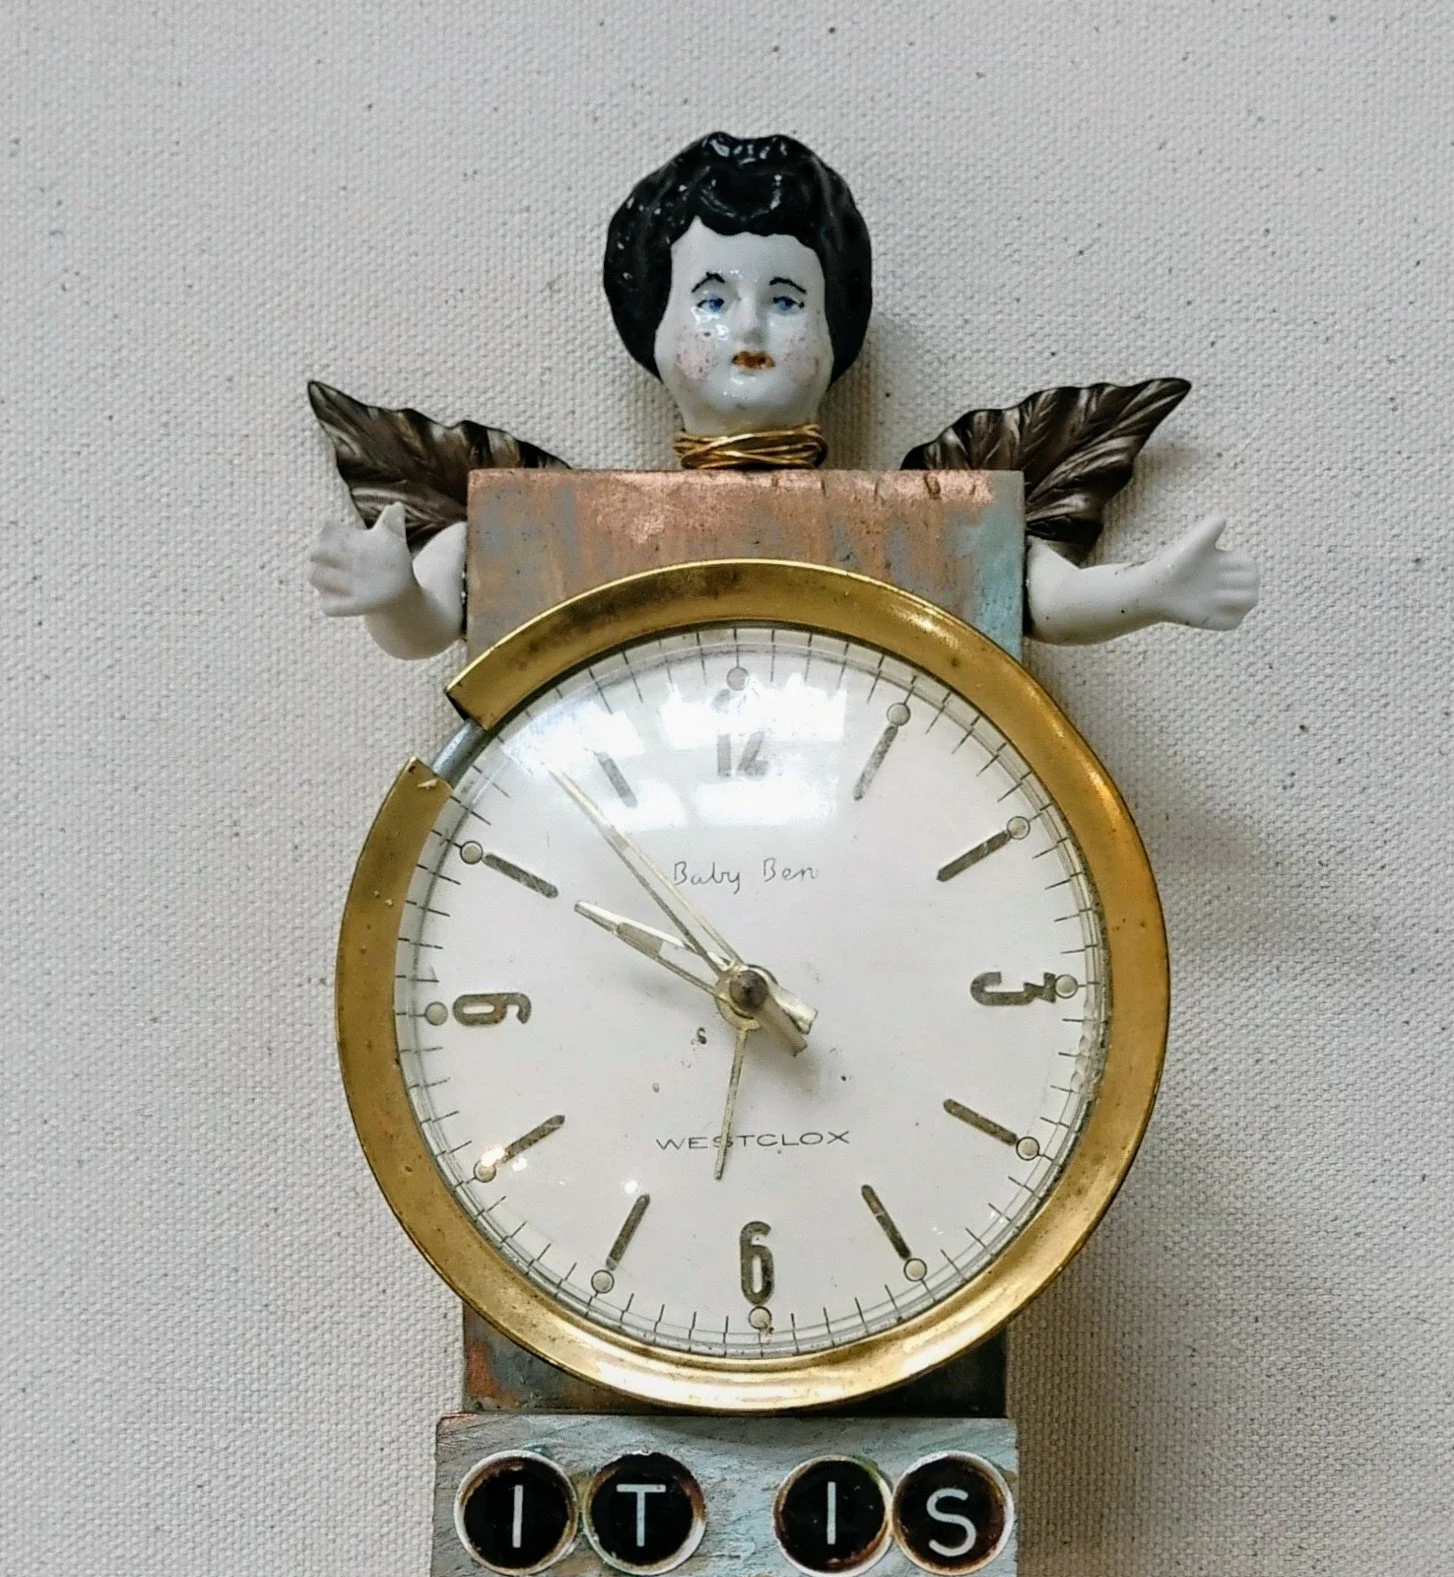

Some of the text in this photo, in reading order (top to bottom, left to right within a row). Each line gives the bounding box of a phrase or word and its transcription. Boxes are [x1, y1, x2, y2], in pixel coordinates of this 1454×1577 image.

[673, 857, 818, 895] Baby Ben
[970, 971, 1056, 1007] 3
[656, 1131, 850, 1150] WESTCLOX
[739, 1220, 775, 1305] 6
[511, 1481, 978, 1557] IT IS
